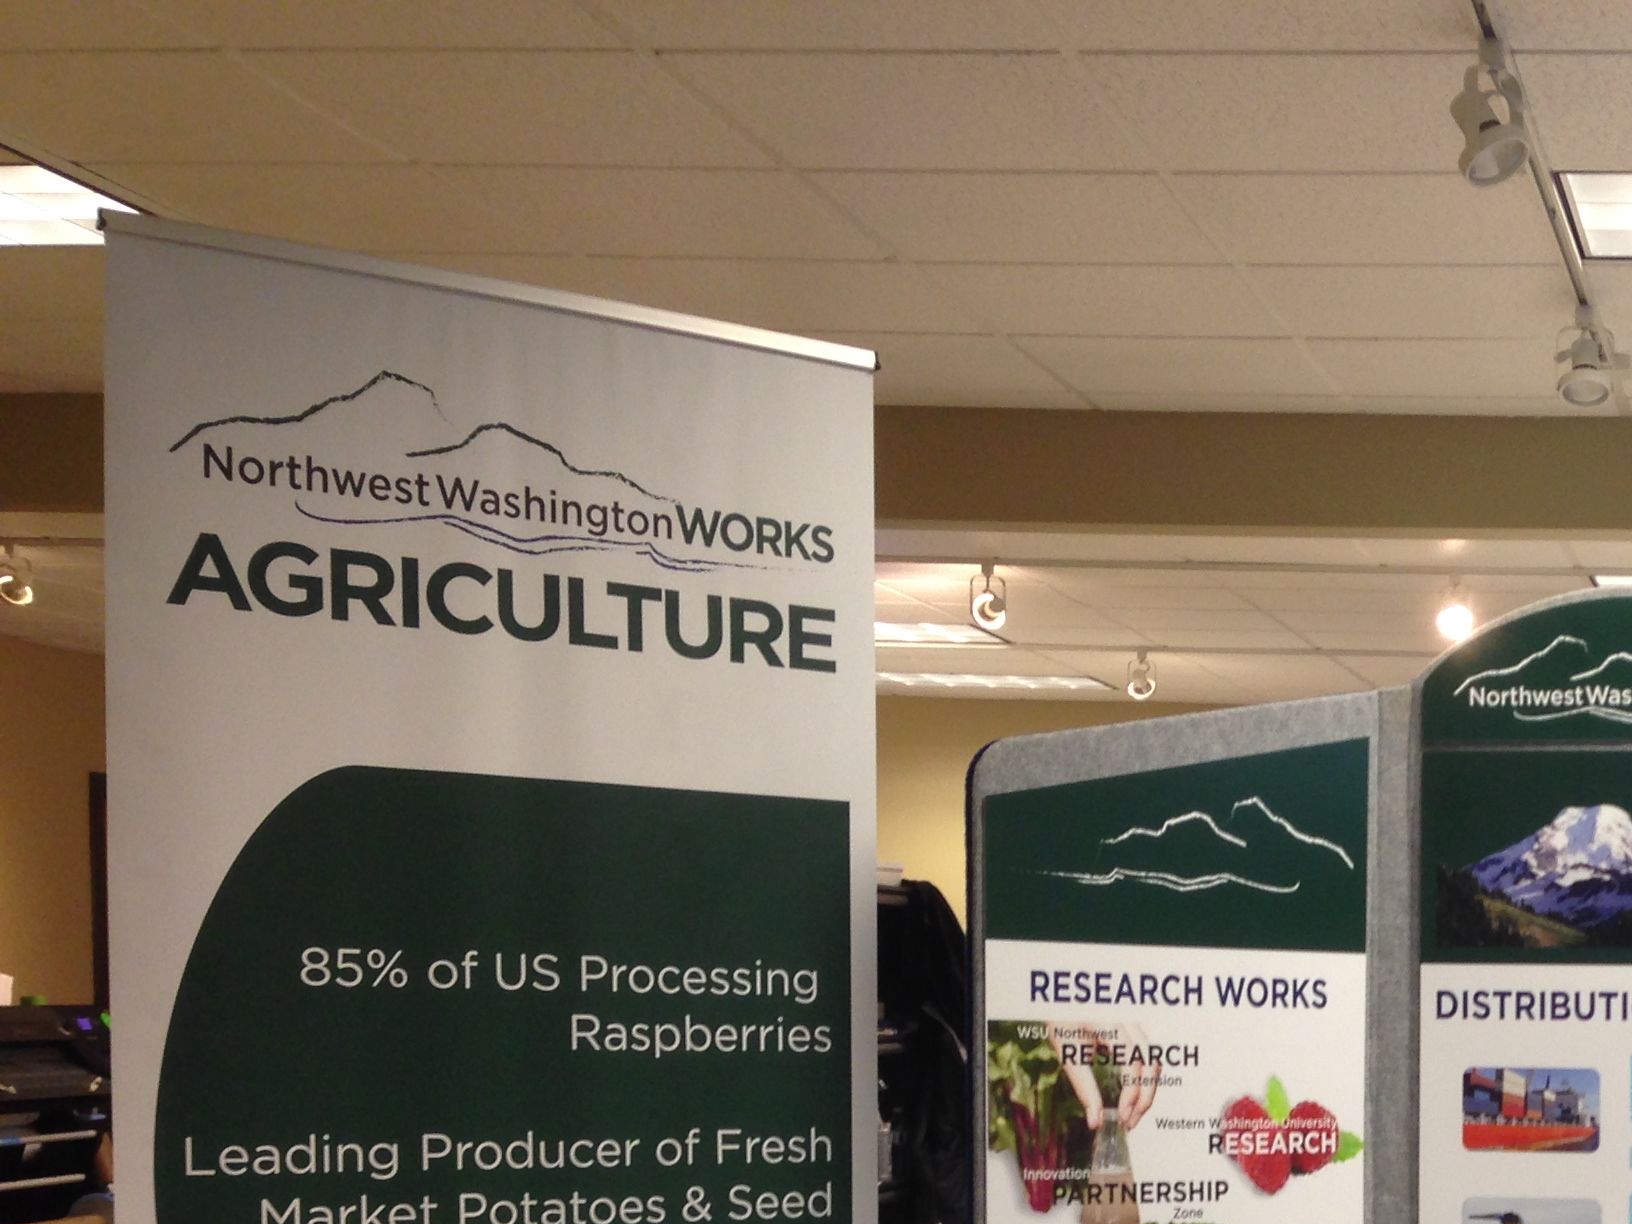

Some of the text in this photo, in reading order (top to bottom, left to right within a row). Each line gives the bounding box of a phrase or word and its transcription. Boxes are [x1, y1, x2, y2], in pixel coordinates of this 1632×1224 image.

[201, 442, 836, 565] Northwest Washington WORKS
[166, 531, 837, 673] AGRICULTURE
[1469, 685, 1584, 707] Northwest
[299, 945, 820, 1004] 85% of US Processing
[1030, 970, 1328, 1009] RESEARCH WORKS
[570, 1014, 832, 1059] Raspberries
[1017, 1025, 1119, 1040] WSU Northwest
[1062, 1044, 1199, 1067] RESEARCH
[1122, 1074, 1183, 1087] Extension
[1155, 1117, 1338, 1132] Western Washington University
[184, 1126, 832, 1181] Leading Producer of Fresh
[1208, 1131, 1337, 1155] RESEARCH
[1024, 1167, 1090, 1181] Innovation
[681, 1186, 713, 1223] &
[727, 1182, 832, 1220] Seed
[1053, 1181, 1229, 1207] PARTNERSHIP
[1173, 1208, 1203, 1219] Zone
